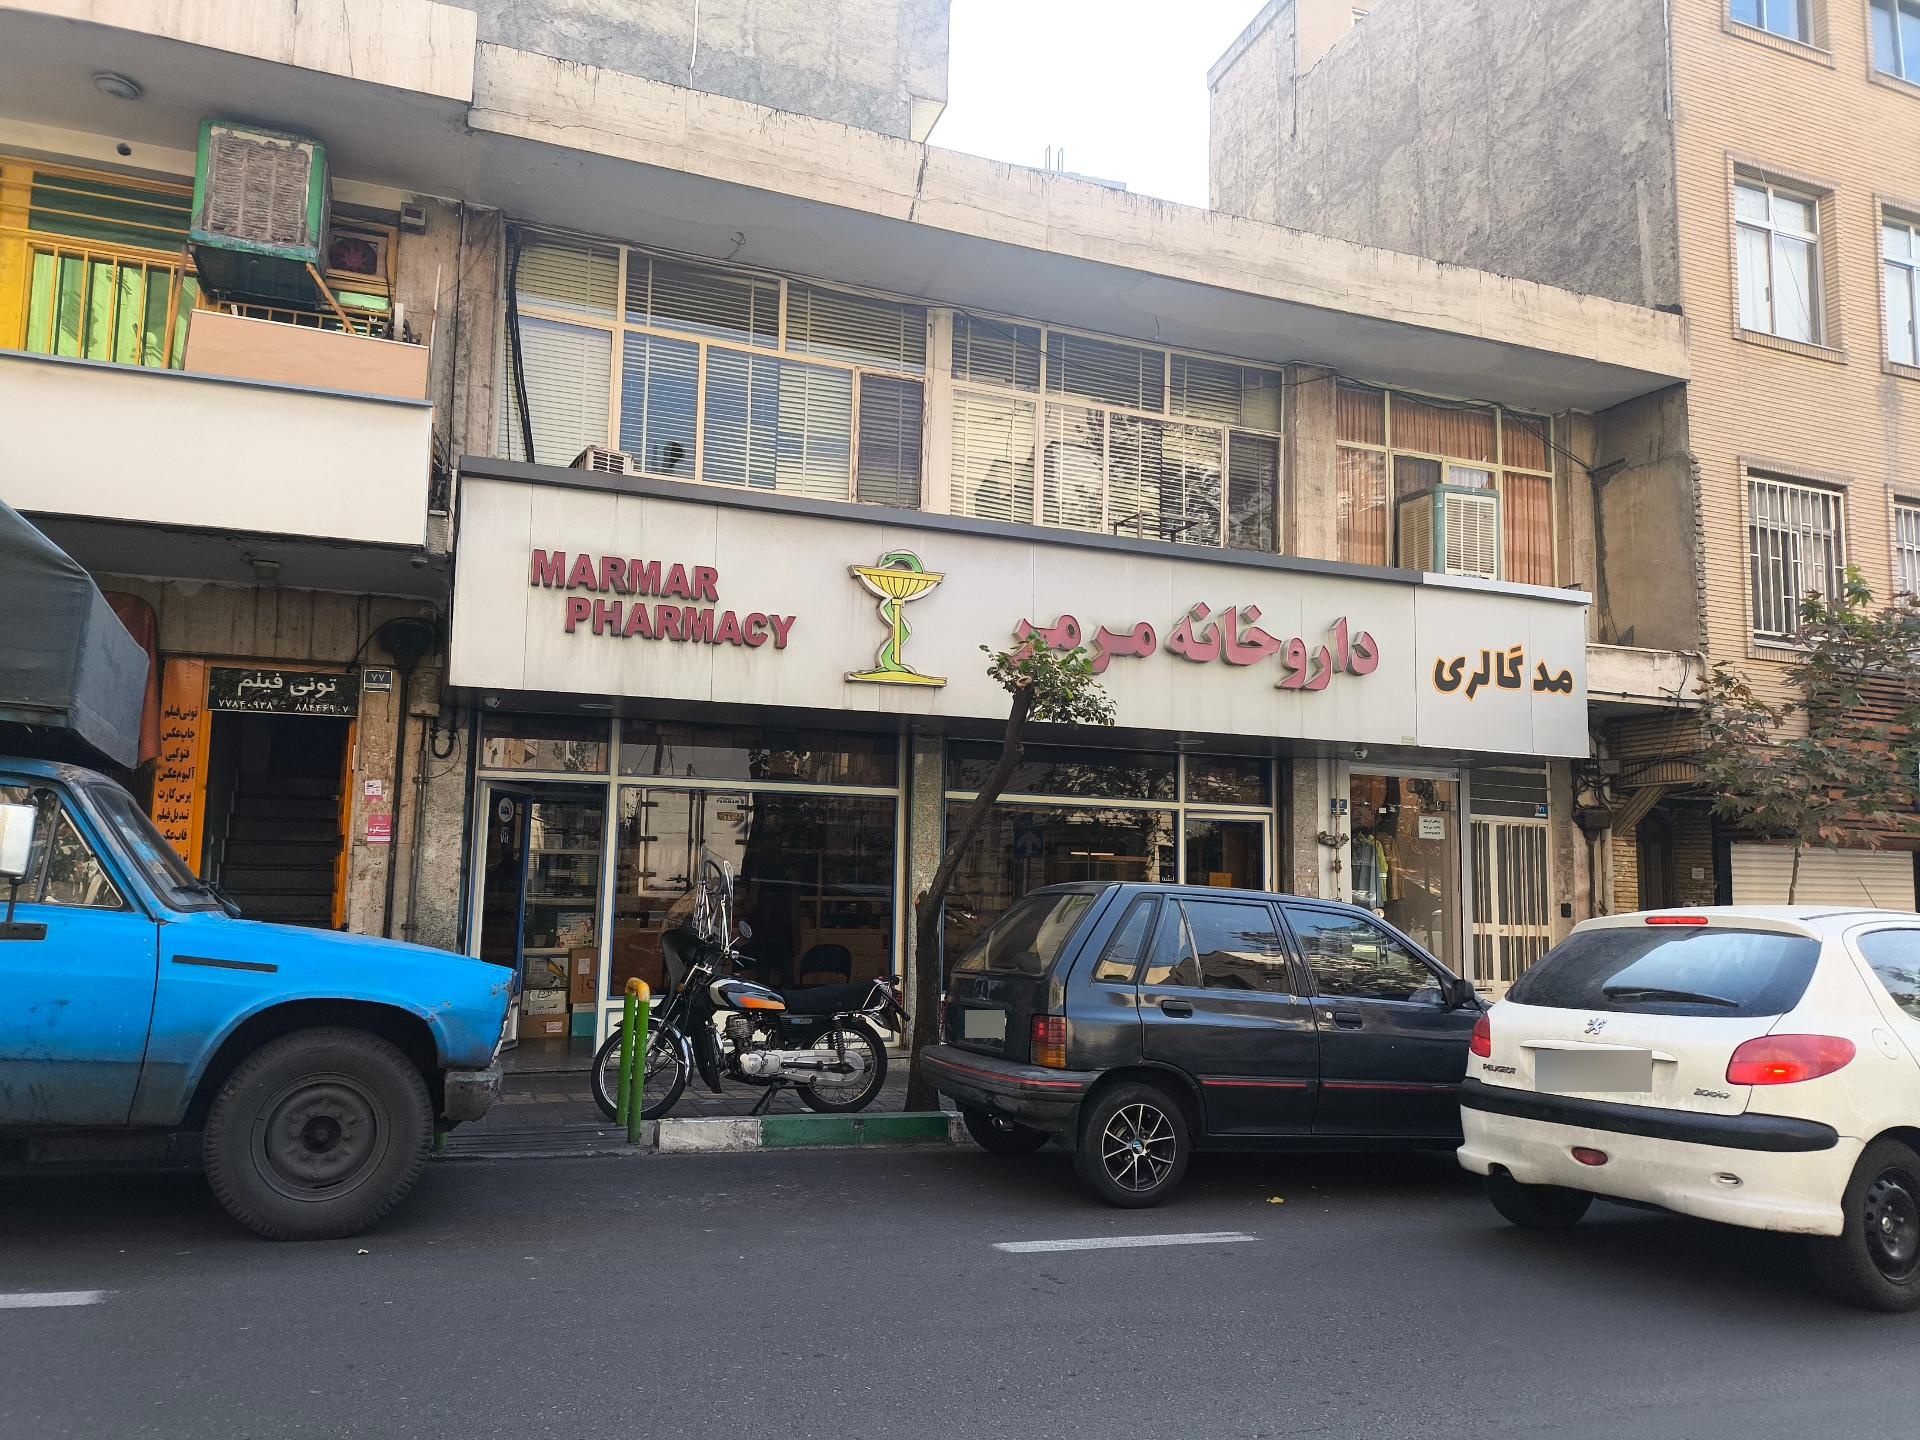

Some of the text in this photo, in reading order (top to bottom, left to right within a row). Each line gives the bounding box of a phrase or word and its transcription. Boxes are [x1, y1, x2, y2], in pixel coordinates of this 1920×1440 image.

[531, 549, 719, 602] MARMAR
[565, 596, 796, 650] PHARMACY
[1010, 602, 1380, 691] داروخانه مرمر
[237, 672, 337, 699] تونی فیلم
[371, 673, 385, 682] ۷۷
[1433, 645, 1574, 701] مد گالری
[1483, 1063, 1517, 1075] PEUGEOT
